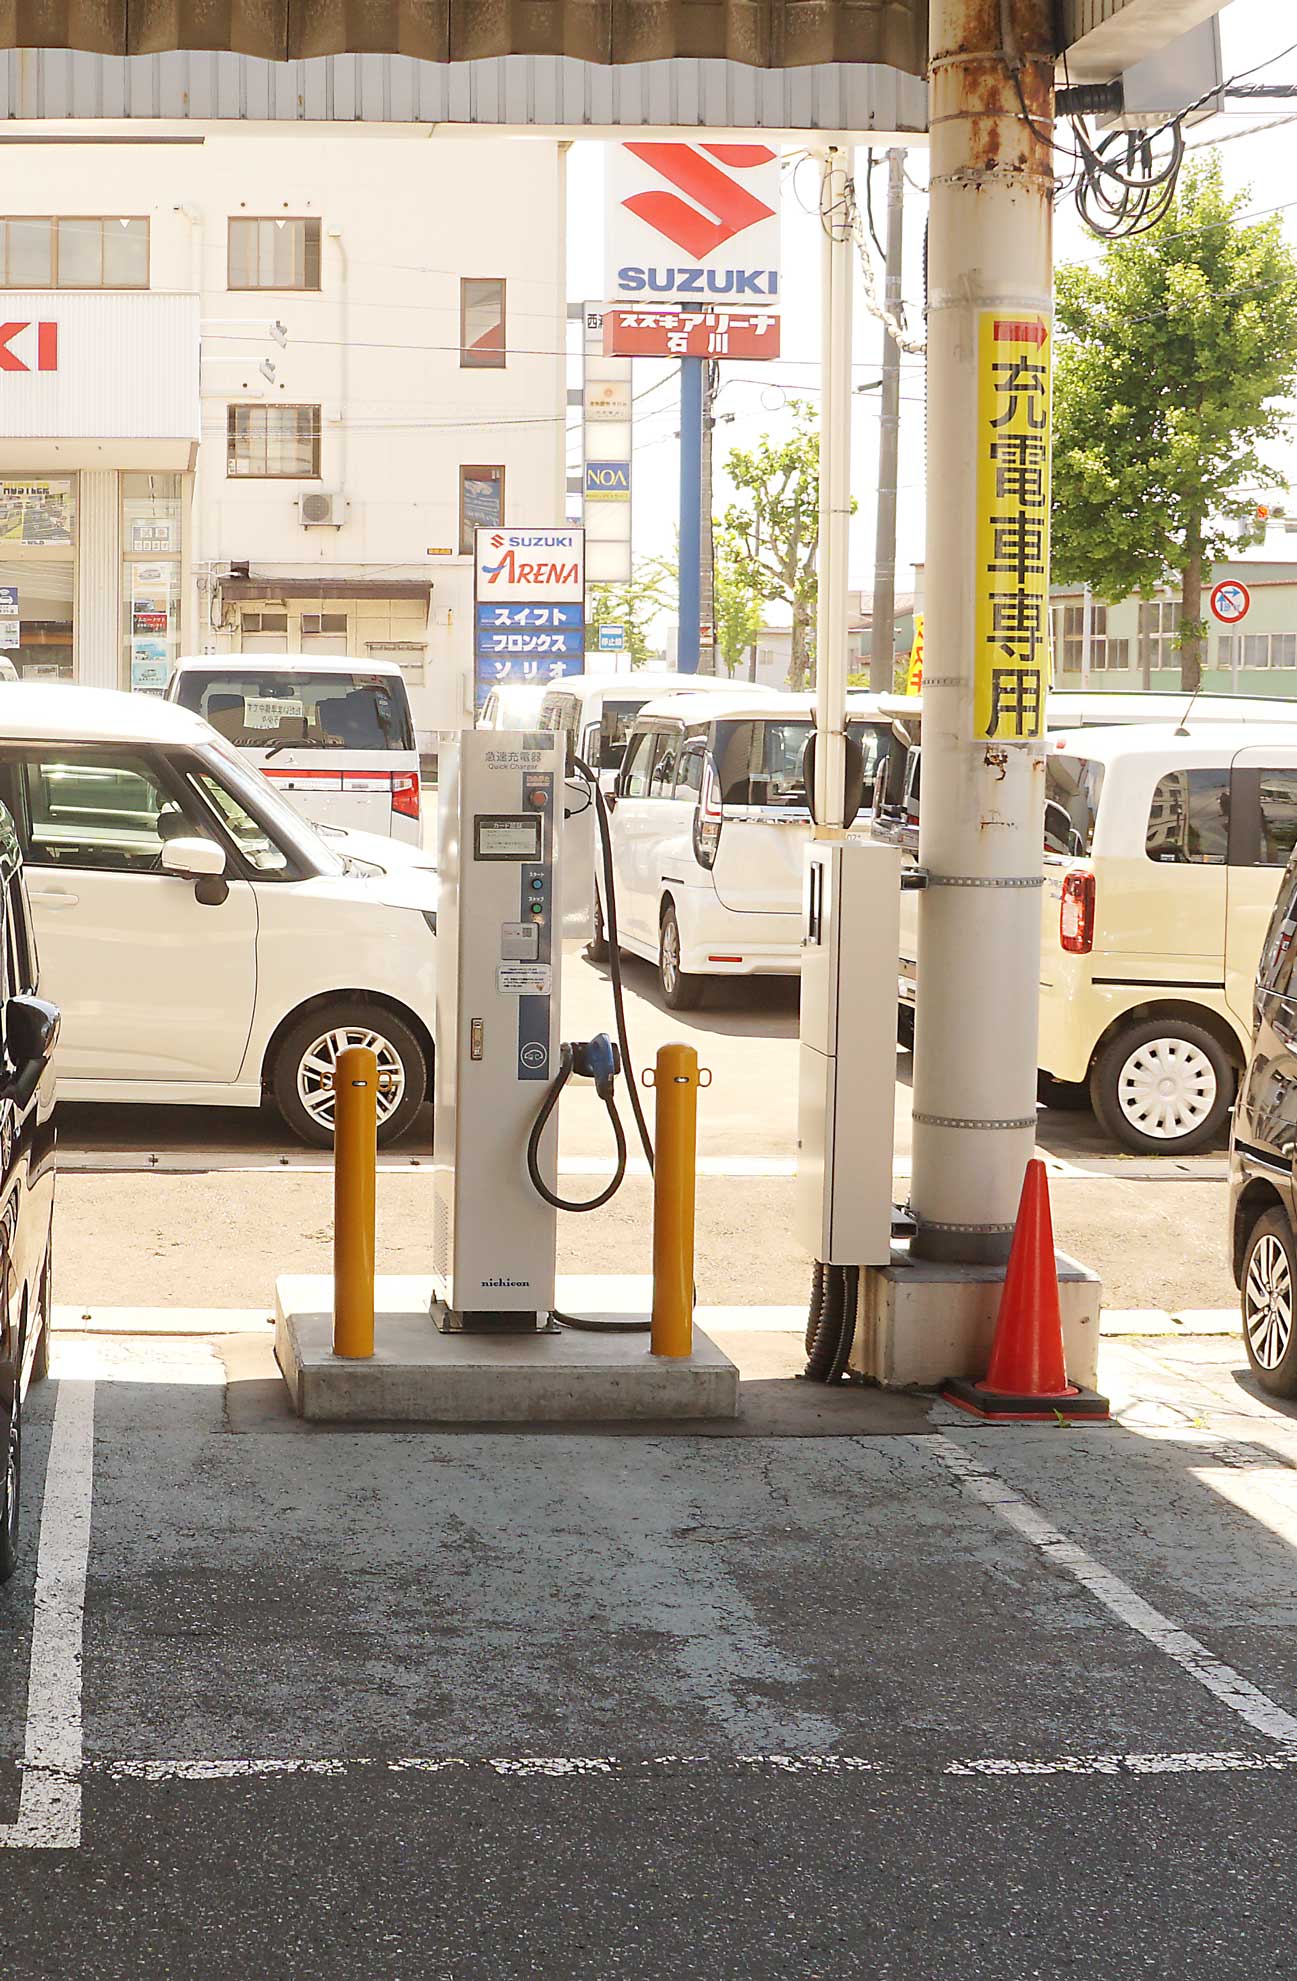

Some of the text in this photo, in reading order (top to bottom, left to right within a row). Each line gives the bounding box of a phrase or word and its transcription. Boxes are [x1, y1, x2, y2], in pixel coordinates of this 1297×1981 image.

[617, 267, 778, 295] SUZUKI
[619, 313, 776, 335] スズキアリーナ
[666, 331, 729, 354] 石川
[587, 469, 628, 487] NOA
[508, 536, 573, 547] SUZUKI
[985, 354, 1048, 738] 充電車専用
[481, 549, 579, 584] ARENA
[494, 608, 568, 626] スイフト
[492, 634, 568, 652] フロンクス
[494, 661, 568, 679] ソリオ
[481, 1278, 530, 1287] nichicon
